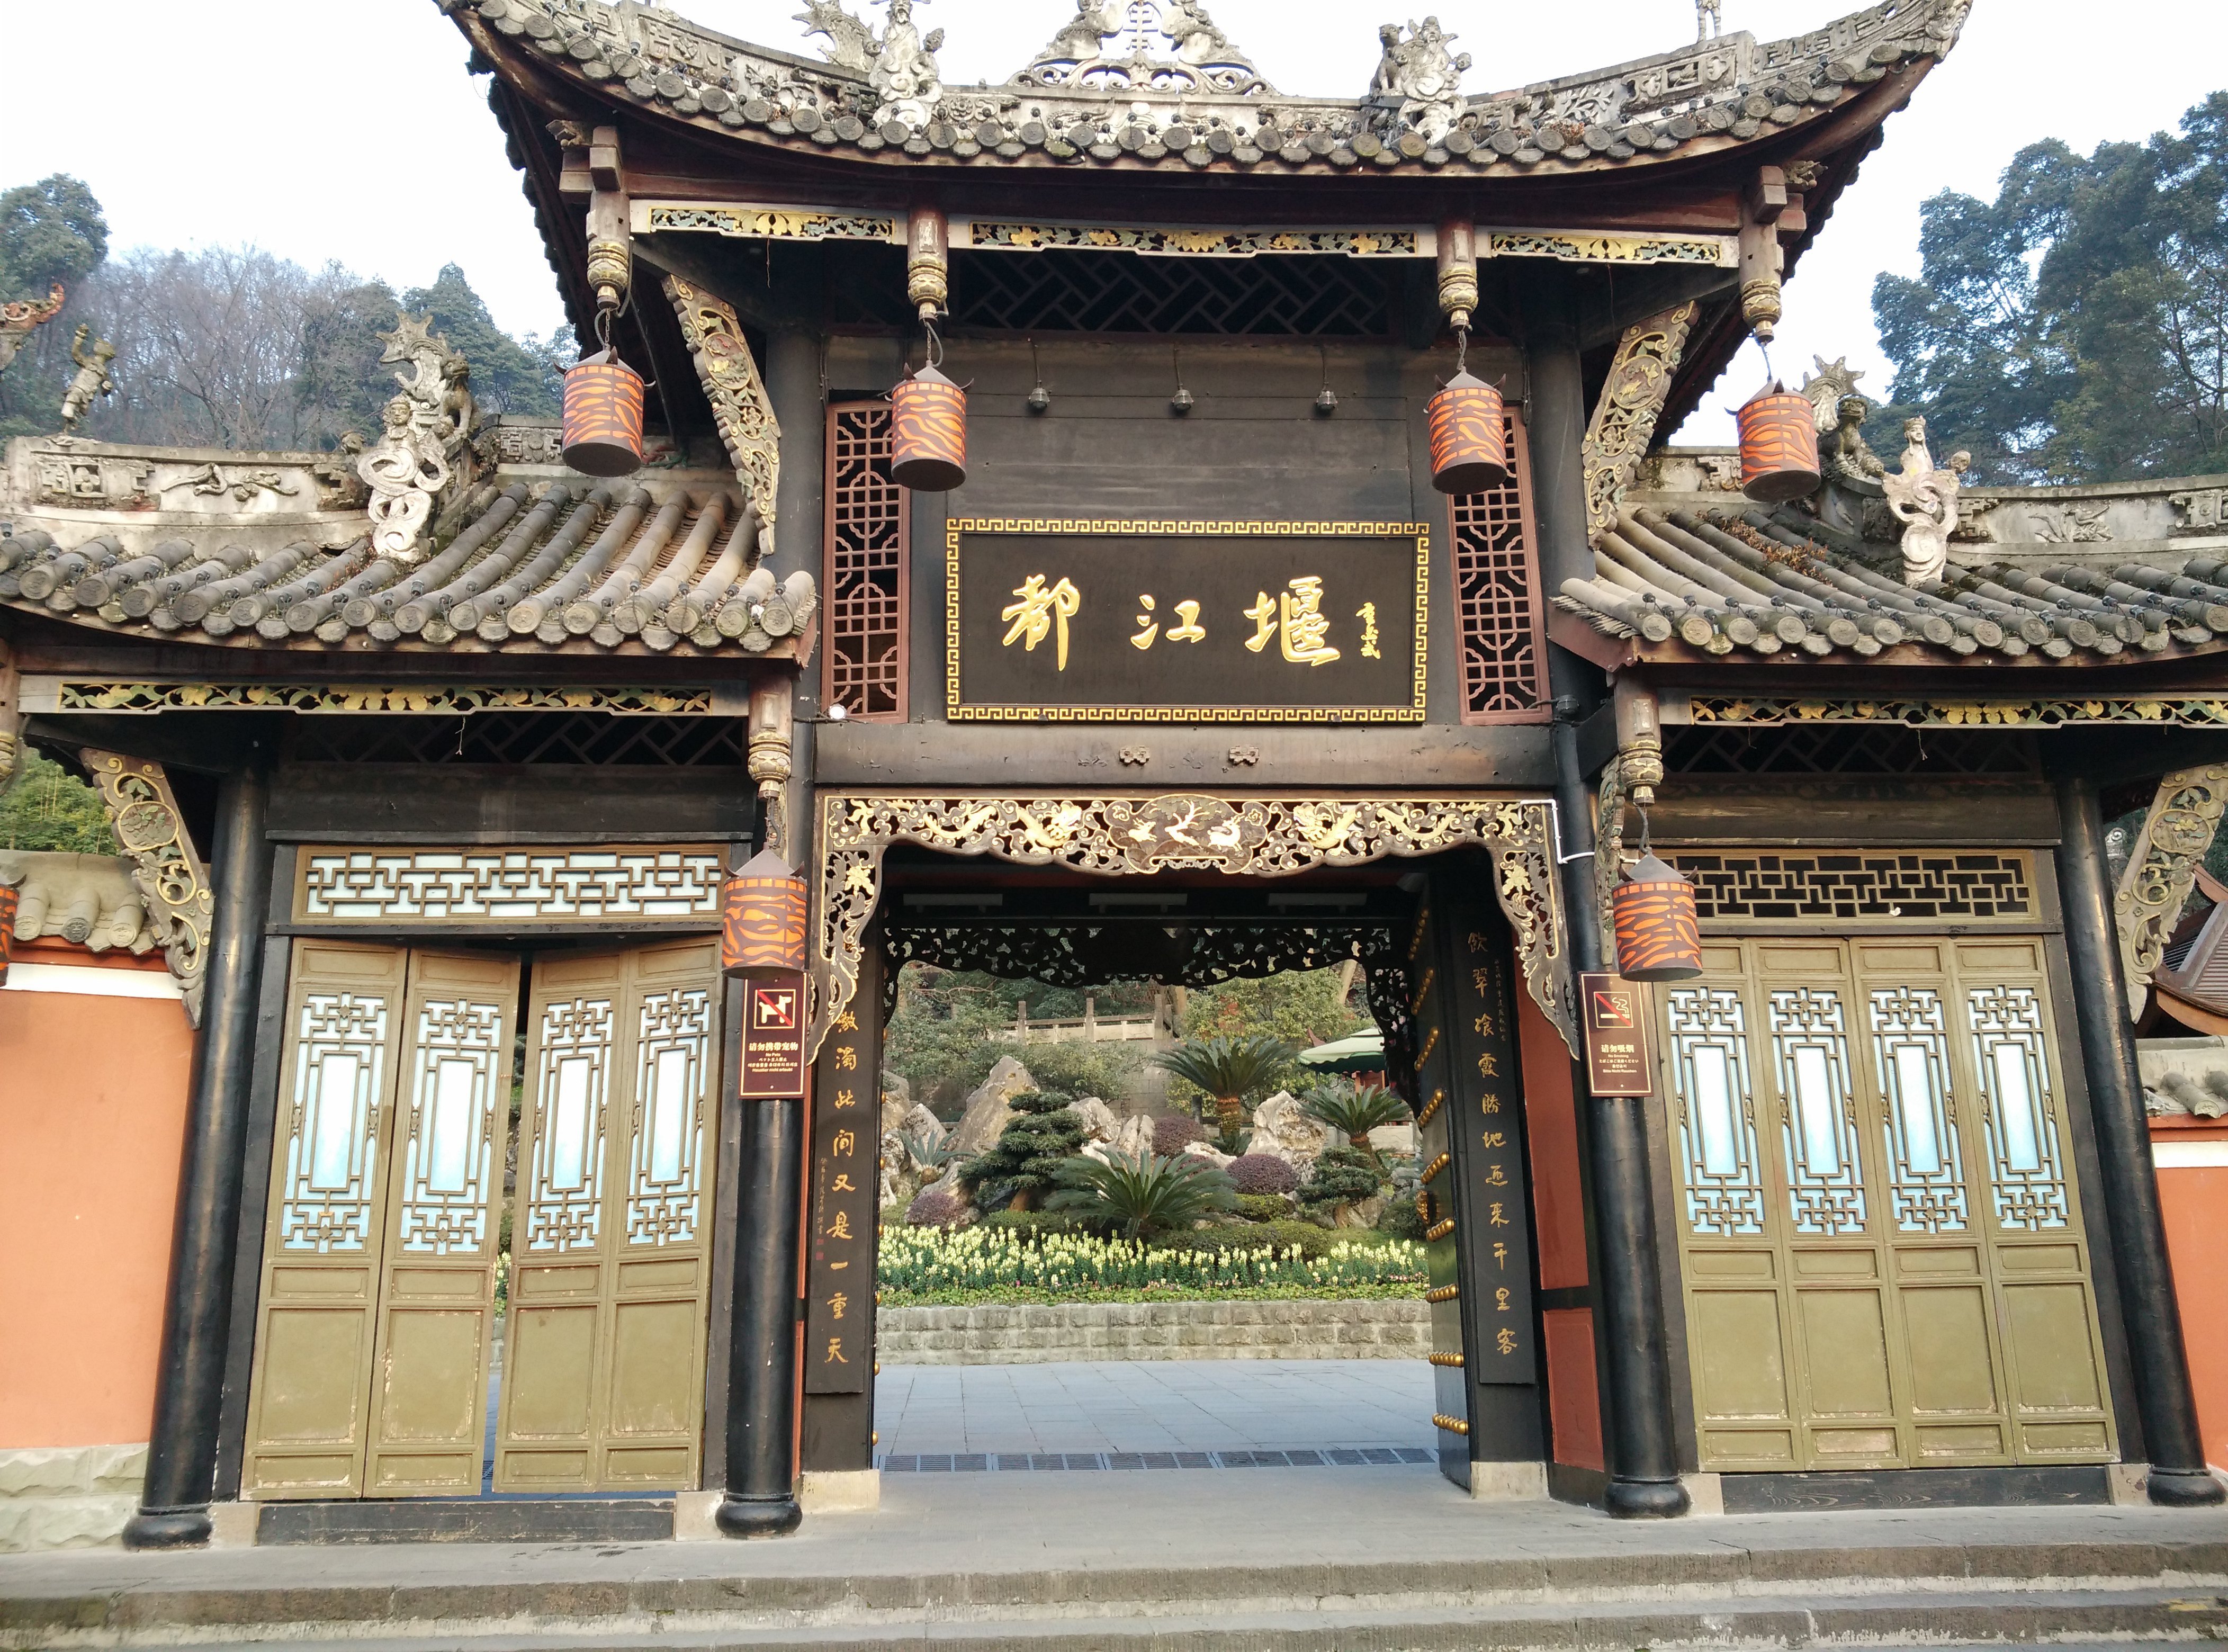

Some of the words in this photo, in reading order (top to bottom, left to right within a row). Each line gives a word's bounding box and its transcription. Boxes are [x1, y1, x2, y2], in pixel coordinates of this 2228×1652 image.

[1001, 574, 1340, 671] 都江堰
[749, 1042, 798, 1051] 请勿携带宠物
[1601, 1044, 1634, 1053] 请勿吸烟
